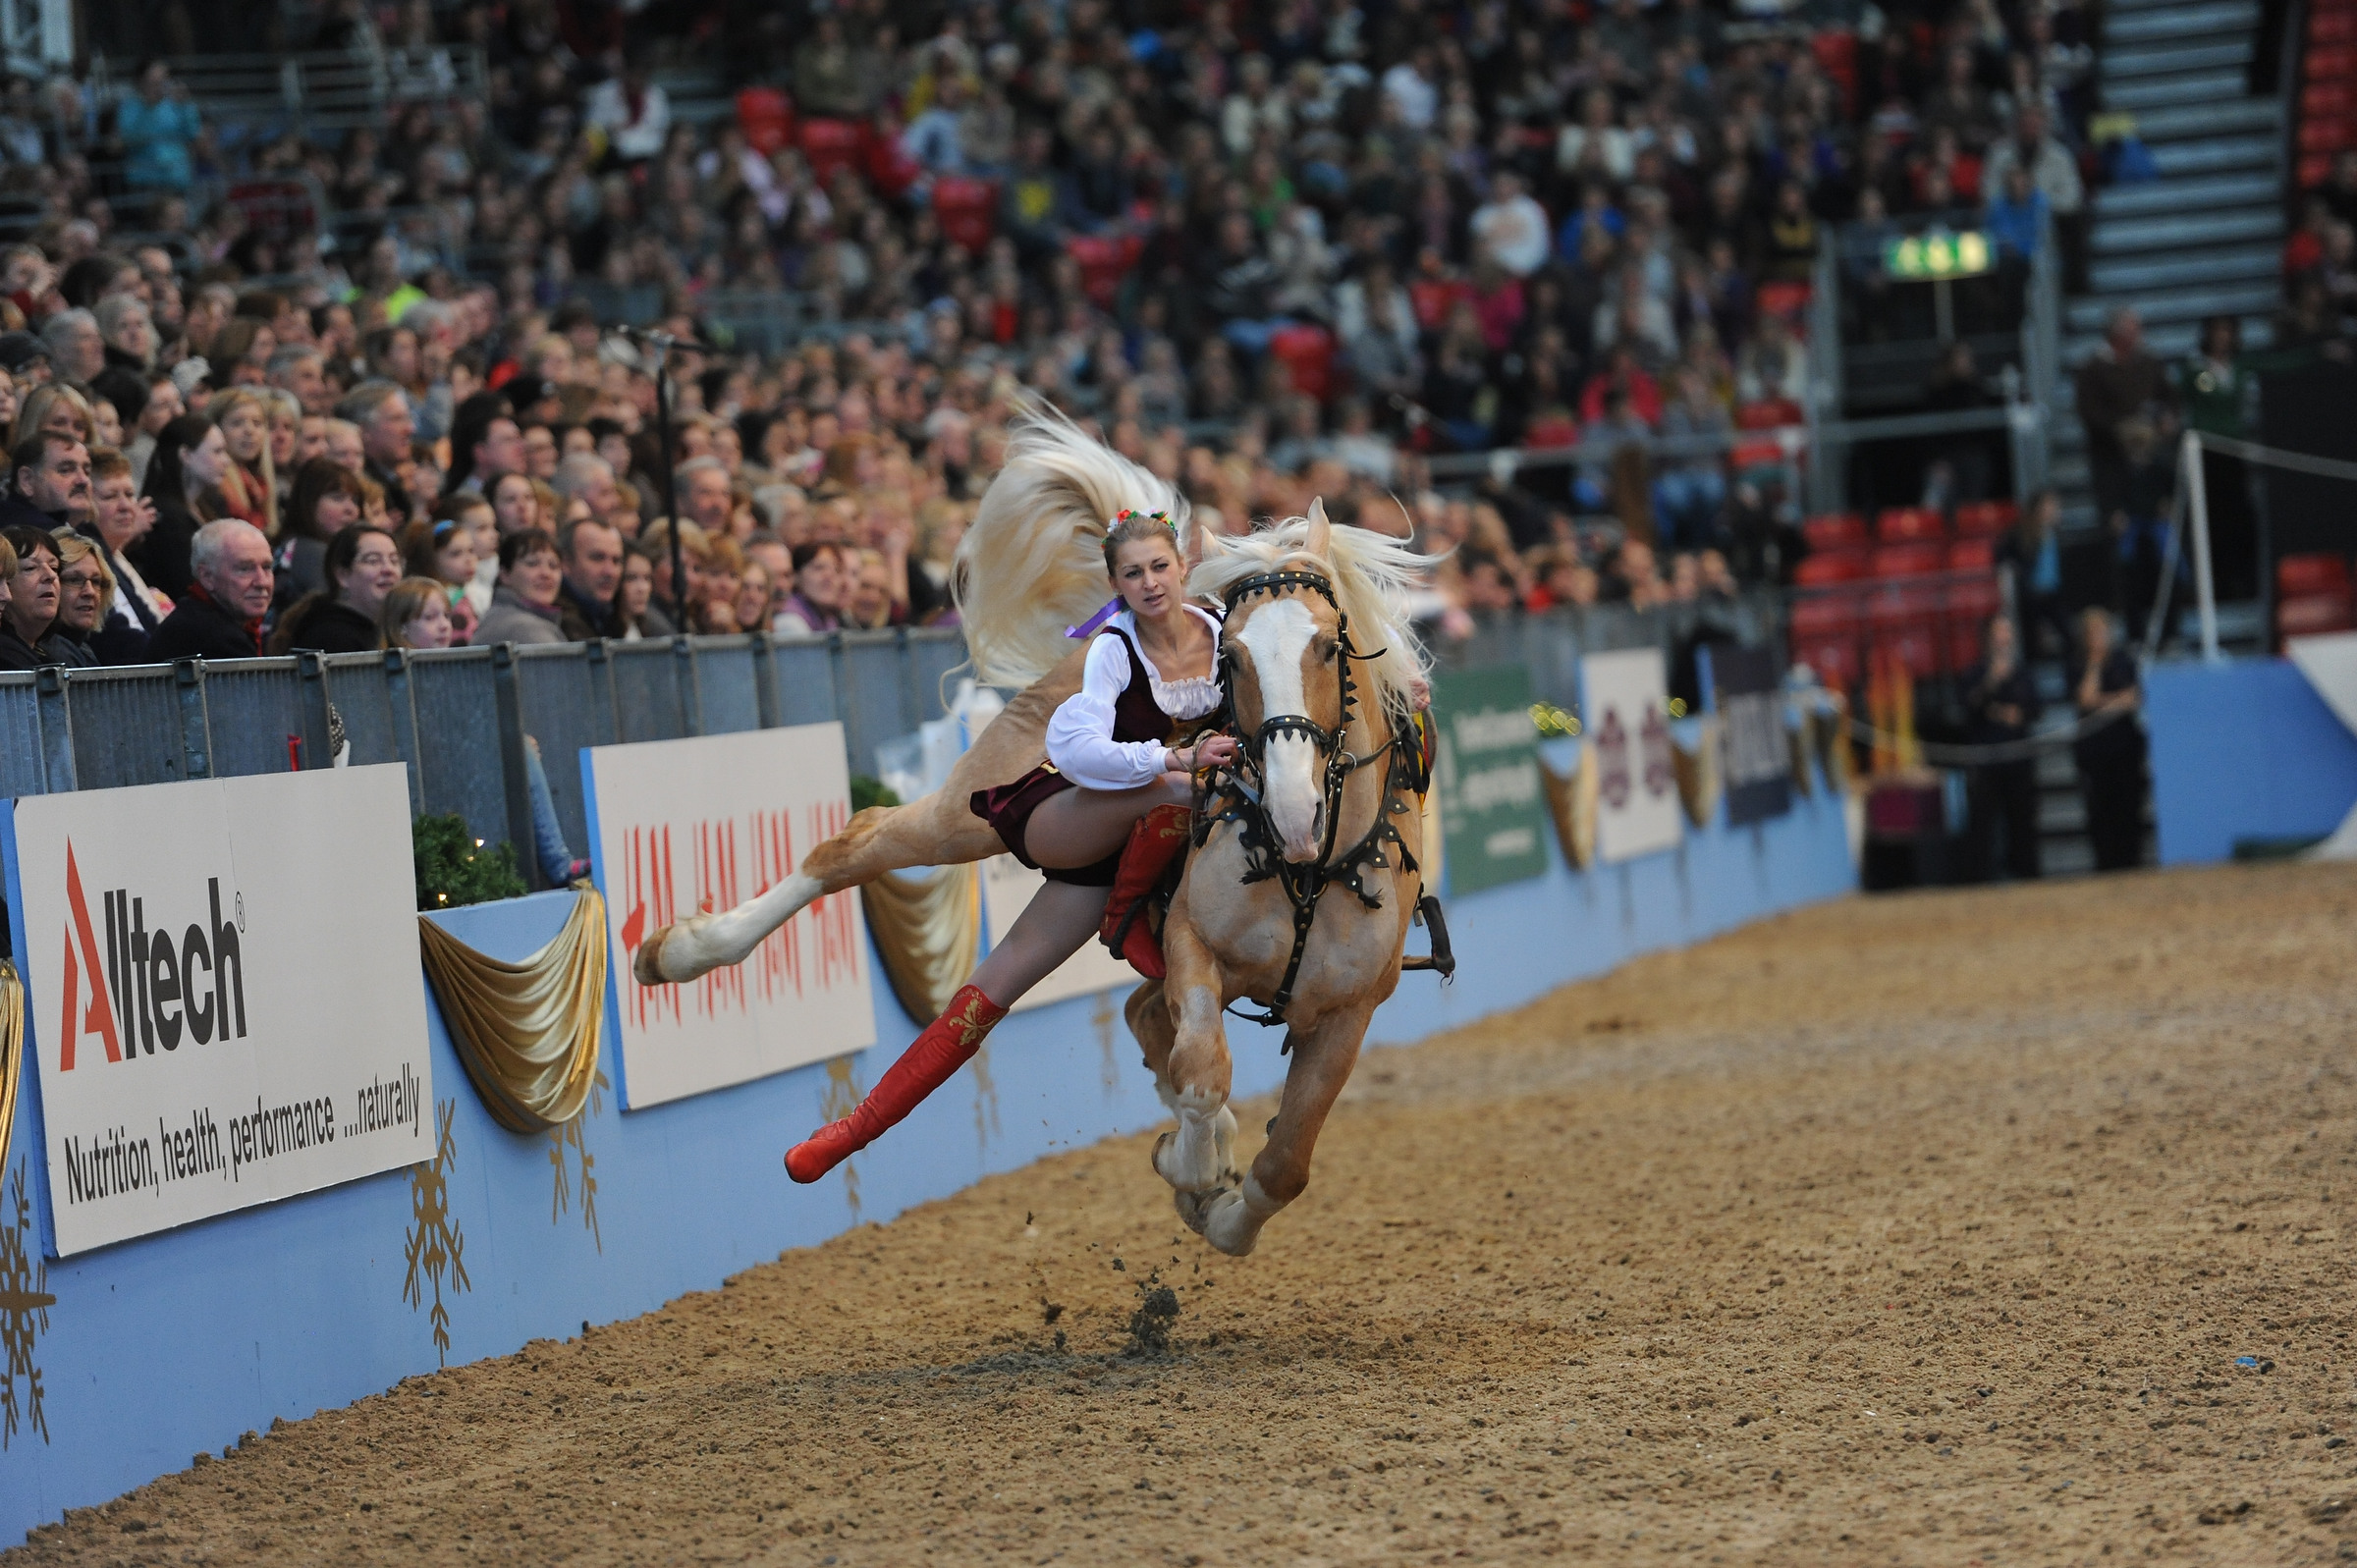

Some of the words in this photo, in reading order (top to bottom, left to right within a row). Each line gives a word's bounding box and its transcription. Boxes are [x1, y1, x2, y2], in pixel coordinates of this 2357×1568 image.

[65, 1125, 159, 1204] Nutrition,
[159, 1107, 227, 1181] health,
[229, 1095, 335, 1182] performance
